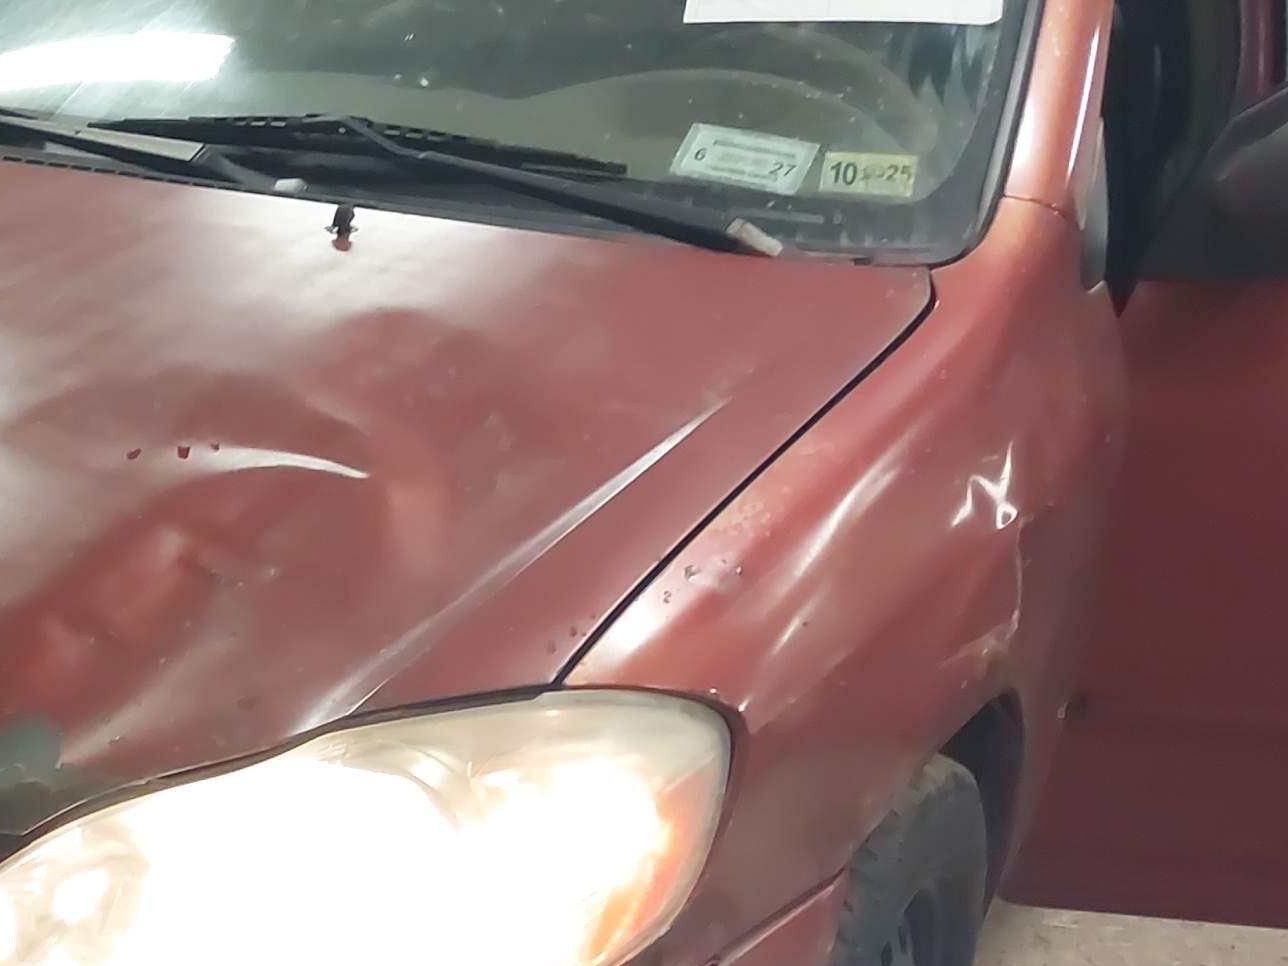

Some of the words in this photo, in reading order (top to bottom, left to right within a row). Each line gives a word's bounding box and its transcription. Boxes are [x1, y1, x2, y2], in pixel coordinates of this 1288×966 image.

[693, 147, 706, 161] 6
[769, 162, 797, 177] 27
[830, 161, 858, 185] 10
